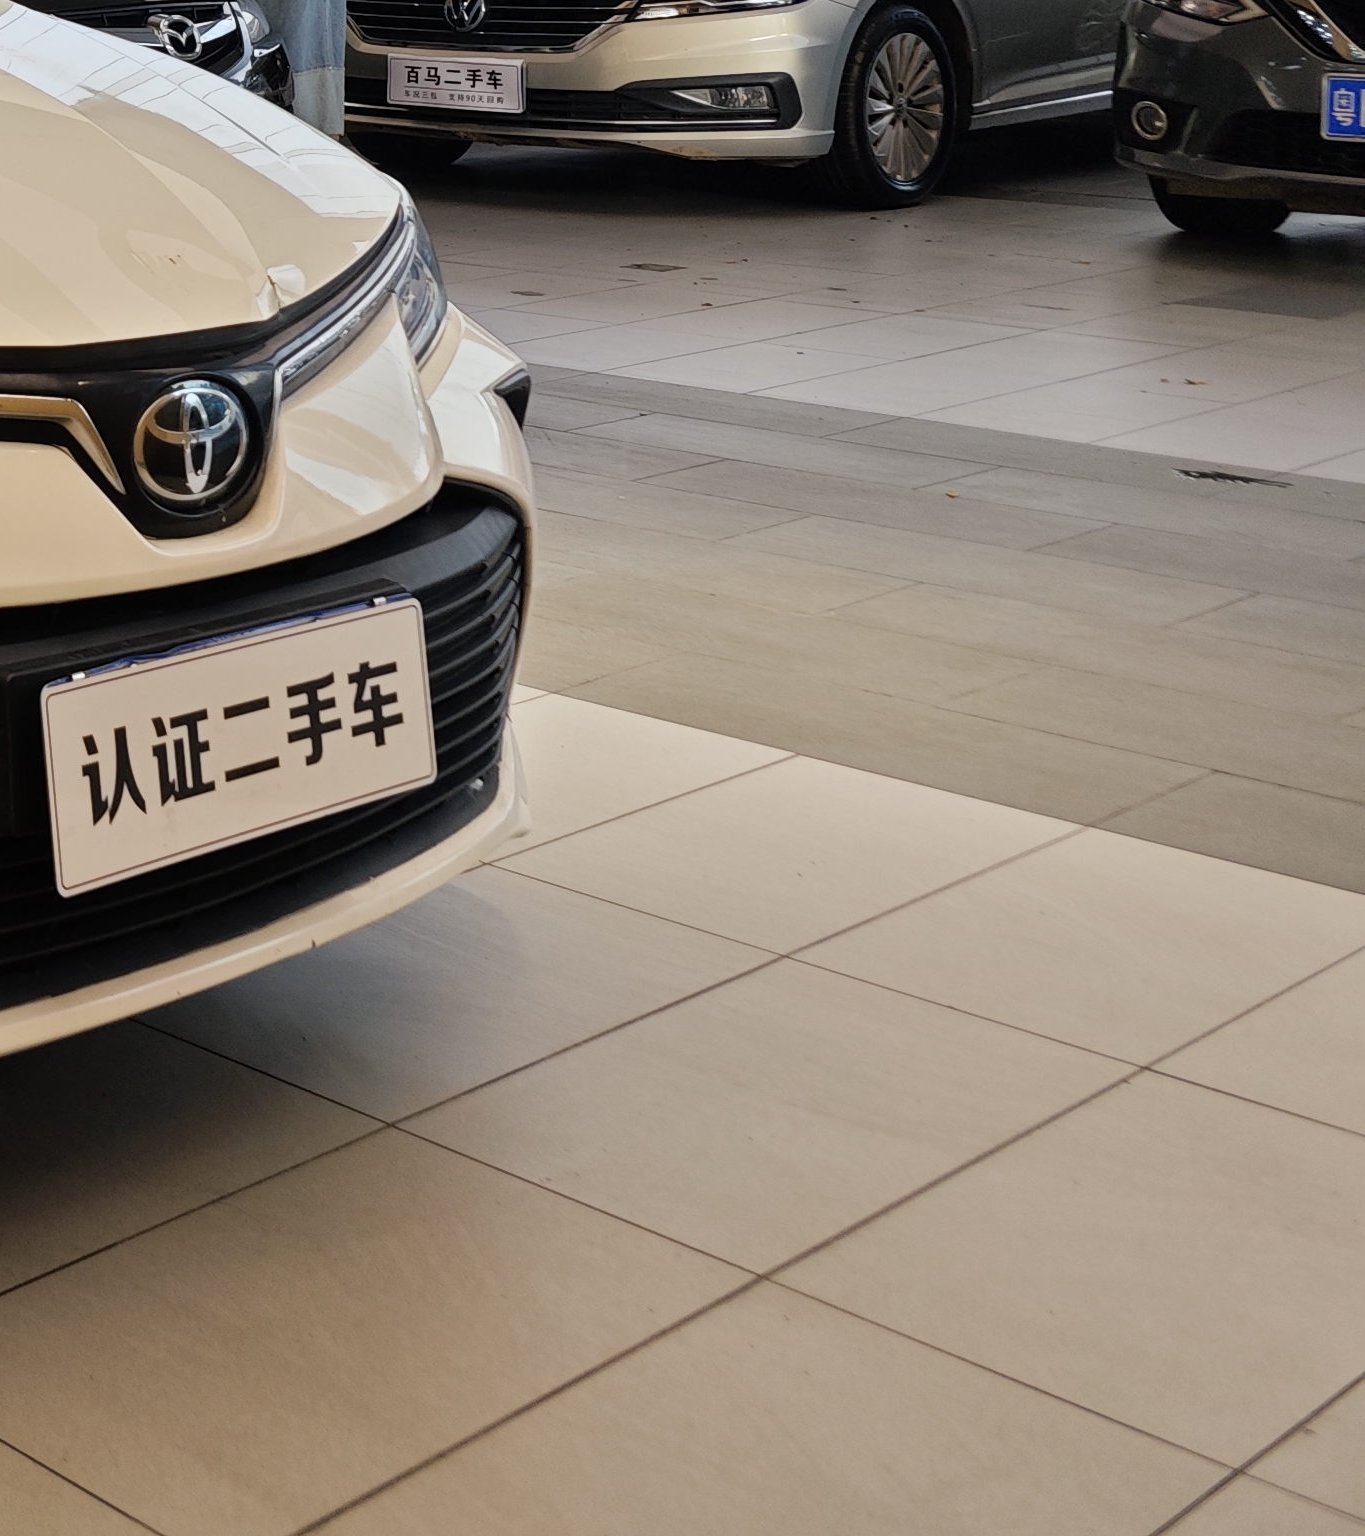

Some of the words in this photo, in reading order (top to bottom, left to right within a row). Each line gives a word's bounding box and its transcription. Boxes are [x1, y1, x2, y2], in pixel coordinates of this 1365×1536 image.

[404, 65, 504, 90] 百马二手车
[404, 90, 438, 100] 车况三包
[448, 93, 505, 104] 支持90天回购
[80, 660, 406, 826] 认证二手车
